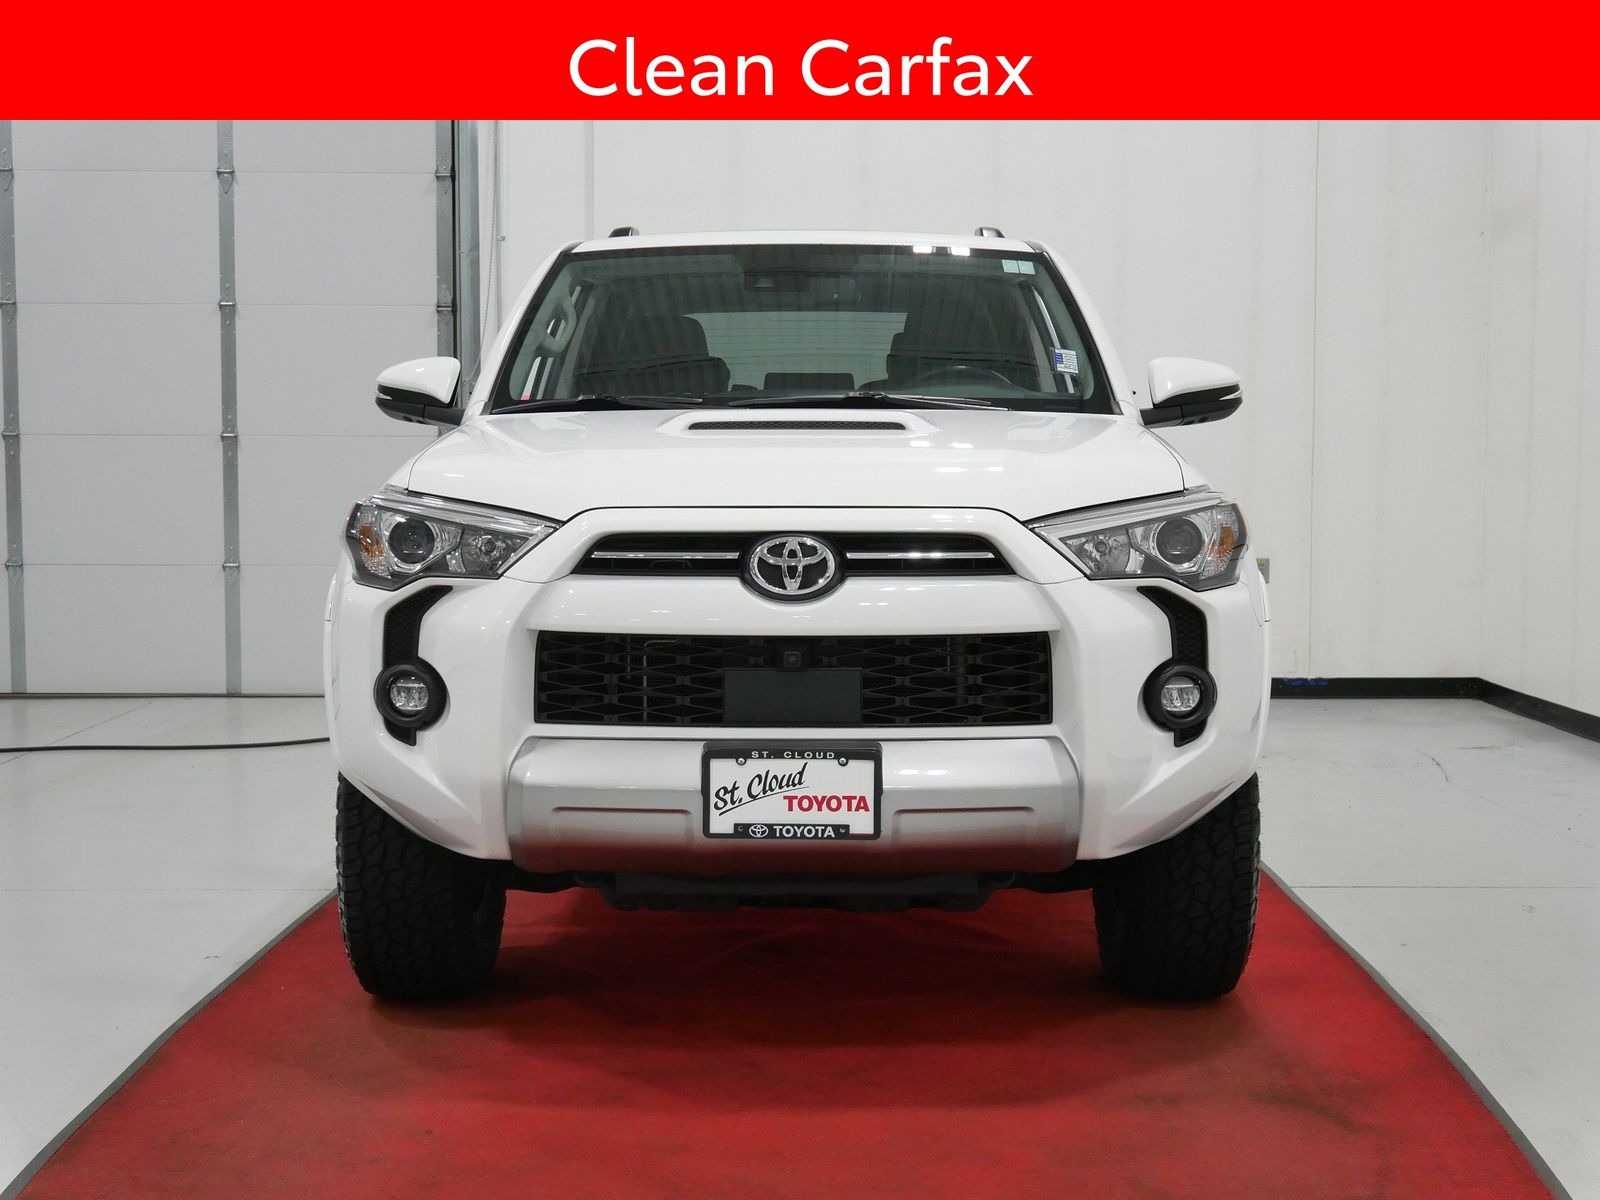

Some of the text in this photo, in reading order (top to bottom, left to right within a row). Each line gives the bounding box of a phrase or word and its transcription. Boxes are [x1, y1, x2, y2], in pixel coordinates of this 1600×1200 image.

[751, 751, 835, 759] ST. CLOUD
[713, 762, 809, 811] St. Cloud
[783, 795, 871, 812] TOYOTA
[773, 825, 836, 838] TOYOTA
